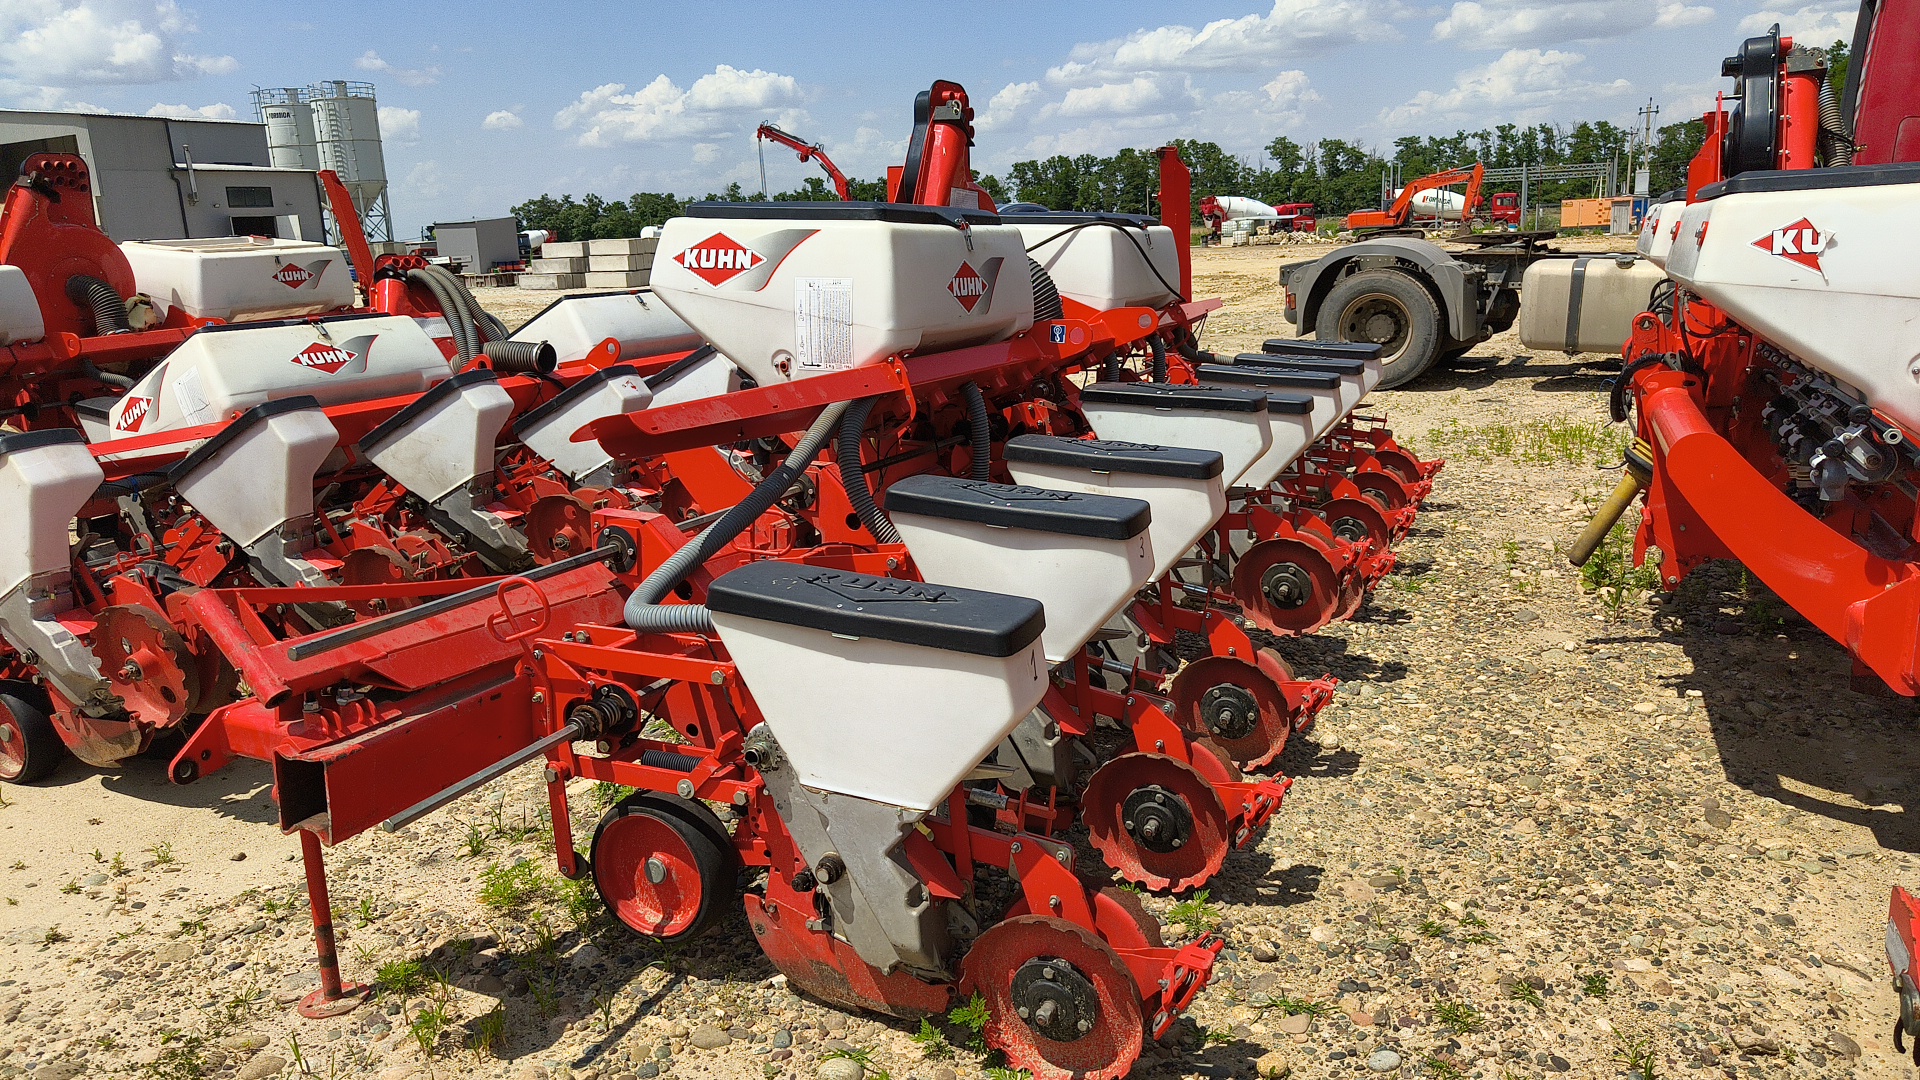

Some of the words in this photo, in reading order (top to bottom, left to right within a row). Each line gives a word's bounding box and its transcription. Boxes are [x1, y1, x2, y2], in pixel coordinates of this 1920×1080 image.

[683, 248, 752, 270] KUHN
[277, 270, 309, 282] KUHN
[952, 277, 983, 297] KUHN
[297, 350, 351, 366] KUHN
[119, 398, 150, 431] KUHN
[1139, 536, 1145, 559] 3
[808, 572, 948, 602] KUHN
[1030, 649, 1039, 682] 1
